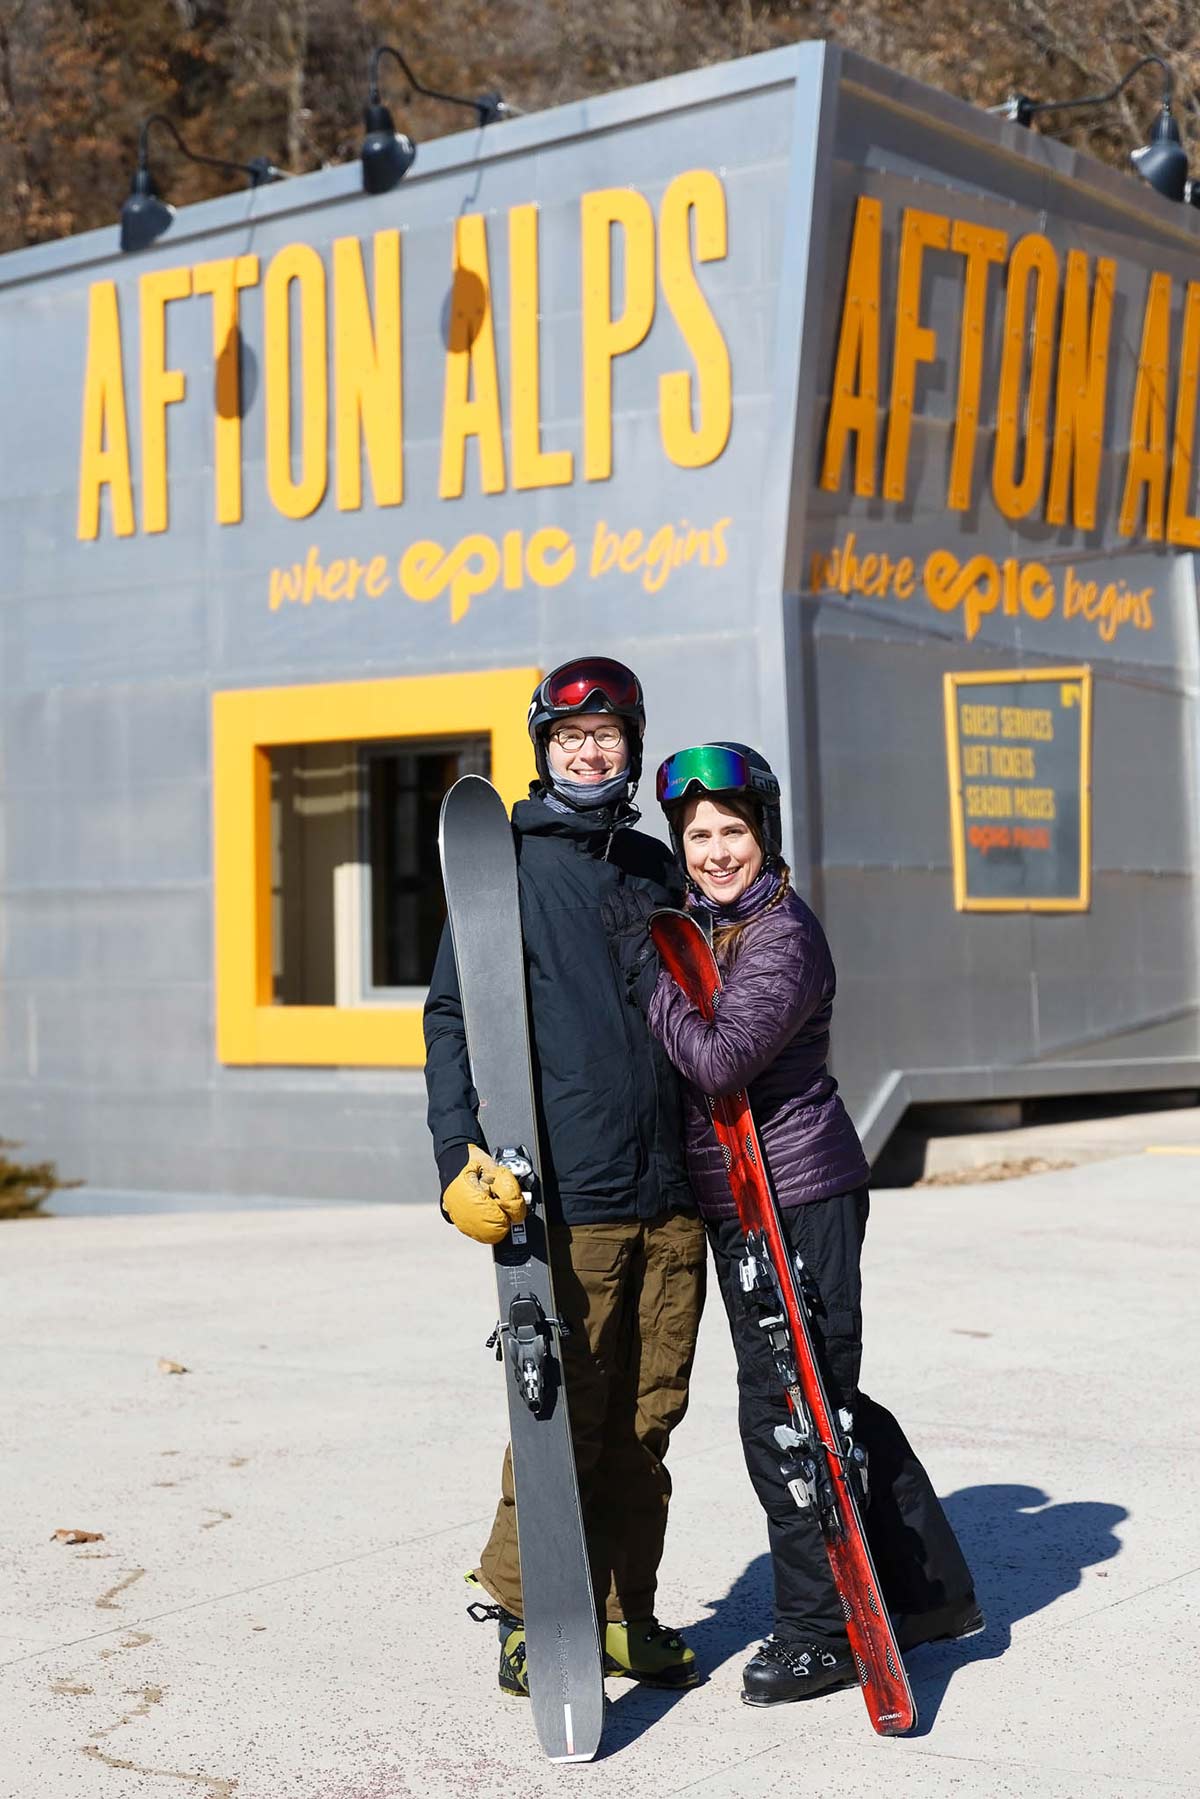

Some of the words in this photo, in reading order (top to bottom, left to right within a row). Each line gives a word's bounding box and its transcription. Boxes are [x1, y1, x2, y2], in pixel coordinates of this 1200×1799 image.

[77, 228, 404, 541] AFTON
[439, 169, 733, 499] ALPS
[820, 194, 1117, 531] AFTON
[268, 546, 390, 611] where
[400, 527, 576, 624] epic
[590, 517, 731, 593] begins
[810, 532, 918, 600] where
[922, 549, 1056, 641] epic
[1063, 566, 1154, 642] begins
[961, 704, 998, 736] GUEST
[1000, 706, 1053, 741] SERVICES
[964, 744, 987, 776] LIFT
[990, 746, 1035, 779] TICKETS
[966, 785, 1012, 817] SEASON
[1014, 787, 1055, 820] PASSES
[877, 1711, 902, 1722] ATOMIC
